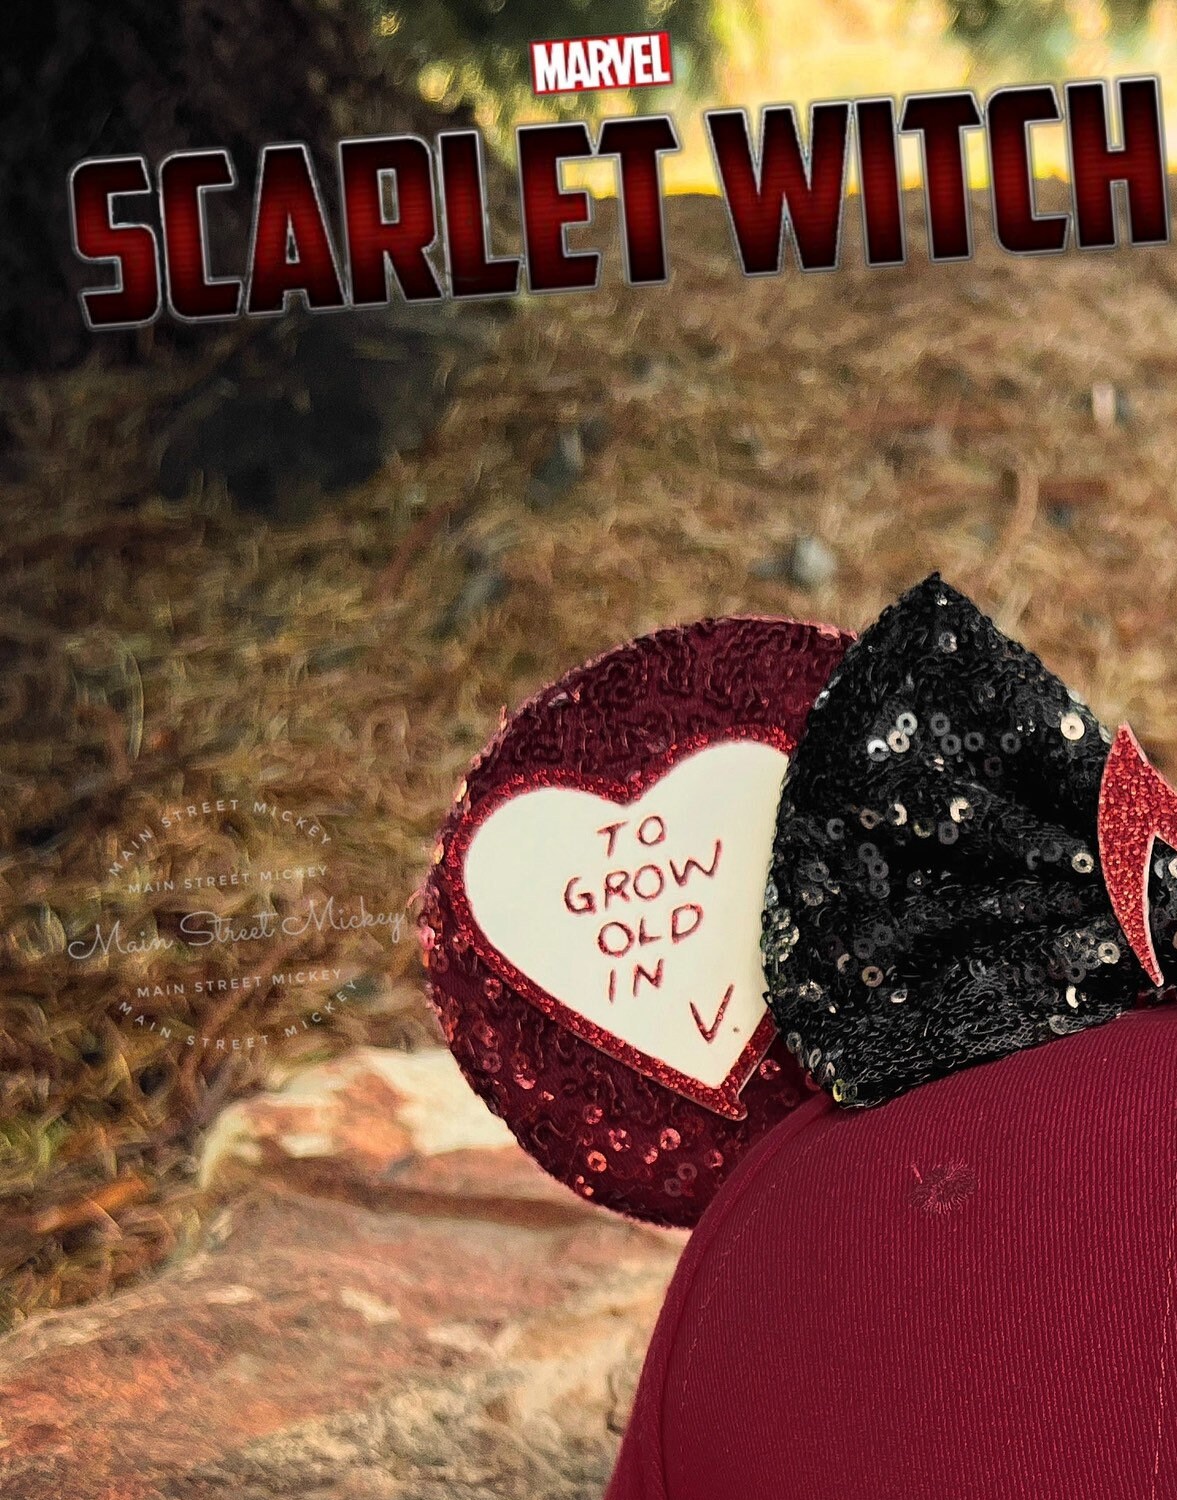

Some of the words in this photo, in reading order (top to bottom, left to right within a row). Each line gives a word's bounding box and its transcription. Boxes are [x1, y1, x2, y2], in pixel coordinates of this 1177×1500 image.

[597, 816, 666, 857] TO
[564, 839, 722, 915] GROW
[597, 903, 704, 958] OLD
[609, 958, 665, 1005] IN
